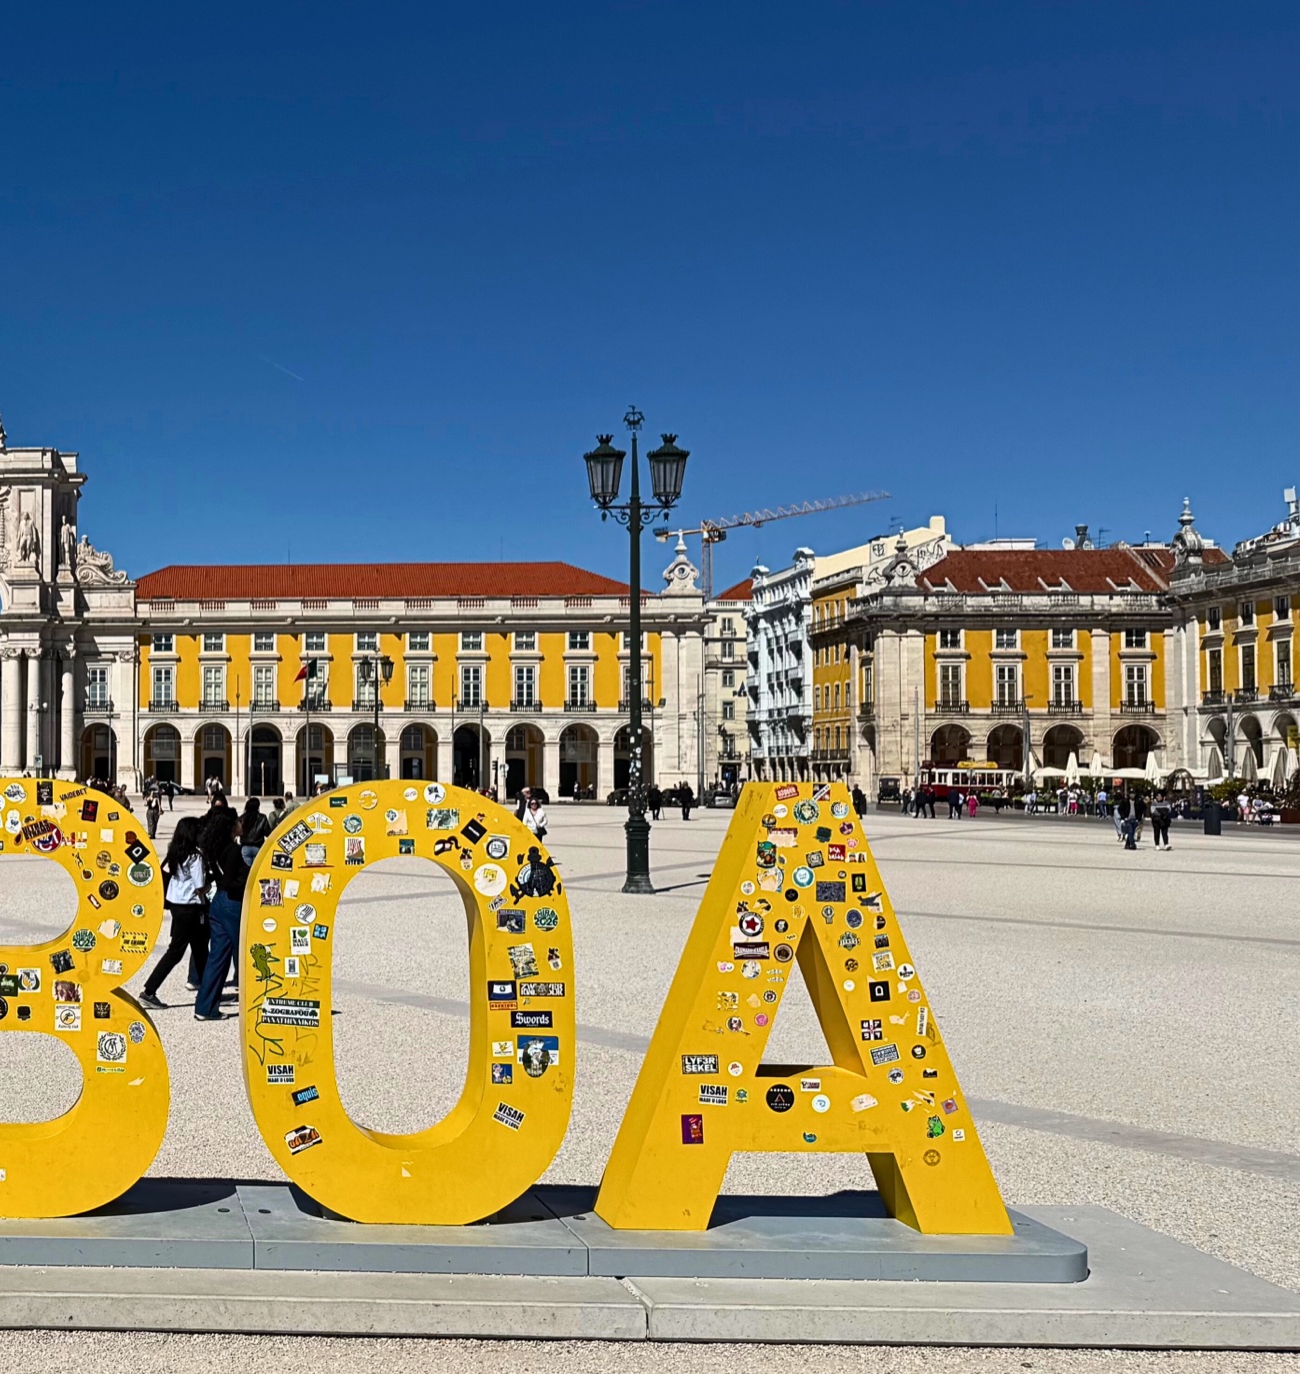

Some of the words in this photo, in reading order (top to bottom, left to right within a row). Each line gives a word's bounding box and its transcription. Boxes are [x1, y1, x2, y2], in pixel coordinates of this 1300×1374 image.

[515, 1012, 550, 1024] Swords
[267, 1065, 294, 1074] VISAH
[700, 1085, 727, 1096] VISAH
[498, 1103, 524, 1122] VISAH
